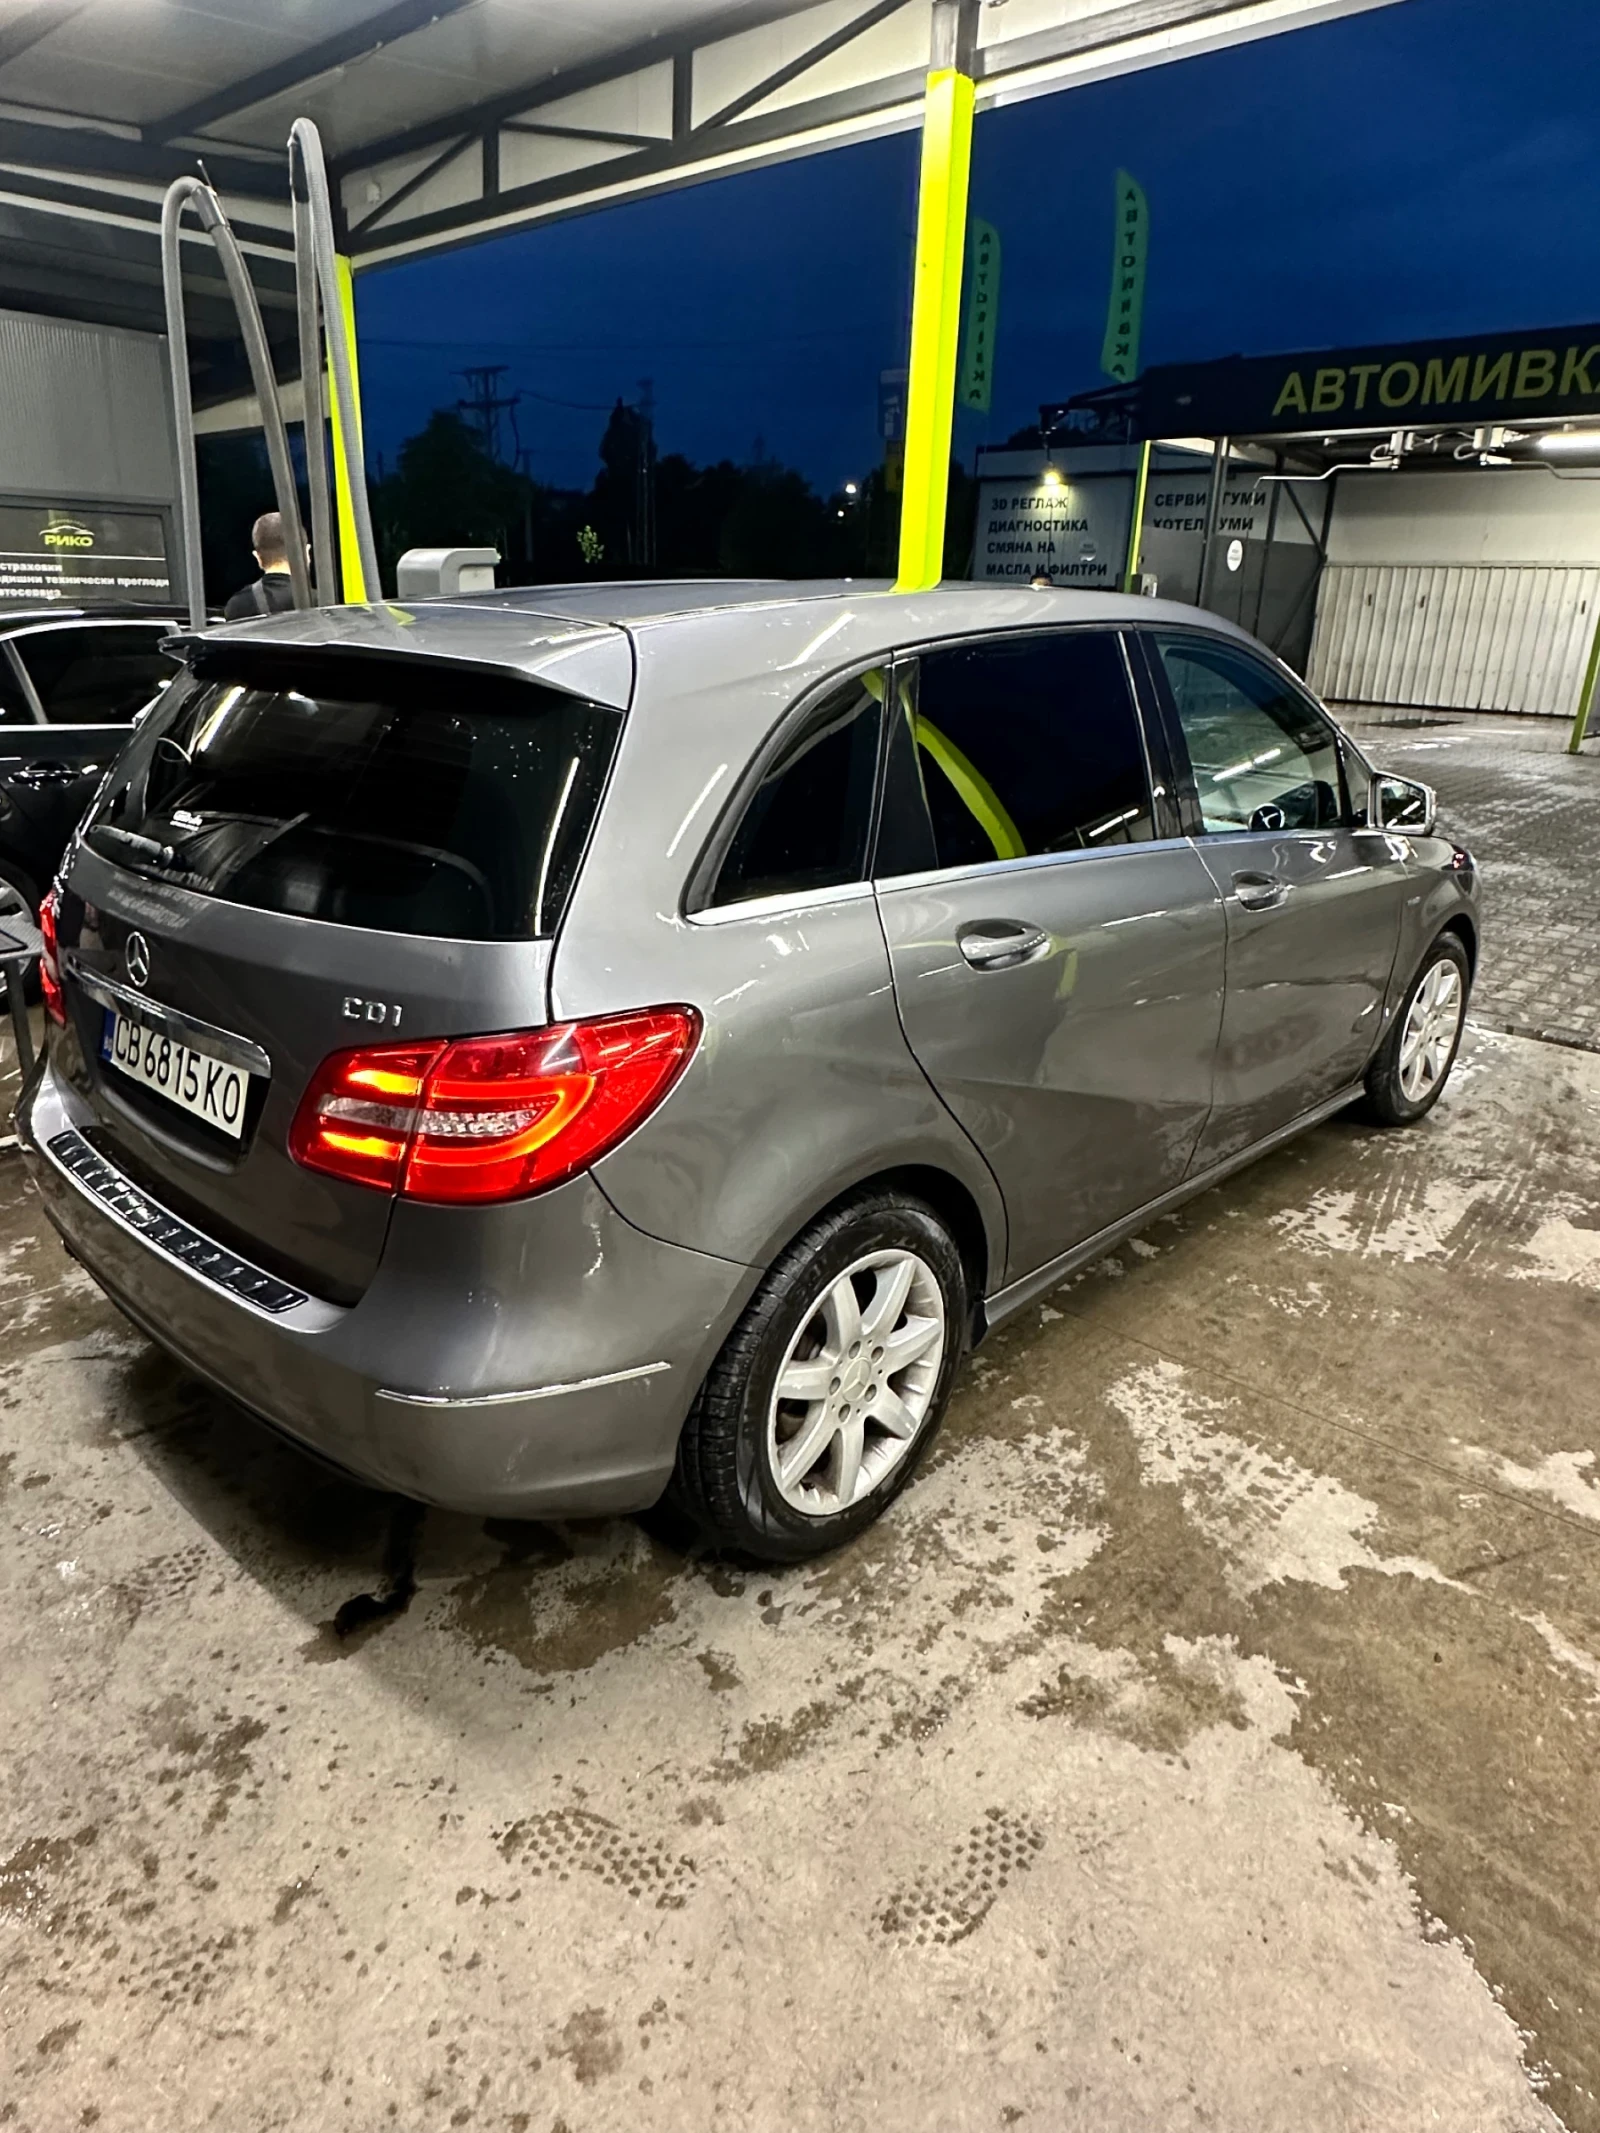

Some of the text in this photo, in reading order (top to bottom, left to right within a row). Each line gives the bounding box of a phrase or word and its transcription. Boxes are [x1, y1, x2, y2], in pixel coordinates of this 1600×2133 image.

[1271, 343, 1600, 417] АВТОМИВК
[1011, 497, 1068, 510] РЕГЛАЖ
[1154, 492, 1207, 507] СЕРВИ
[988, 519, 1089, 534] ДИАГНОСТИКА
[1218, 517, 1254, 531] УМИ
[44, 534, 94, 547] РИКО
[986, 541, 1056, 554] СМЯНА НА
[985, 563, 1032, 576] МАСЛА
[1048, 563, 1108, 576] ФИЛТРИ
[0, 574, 43, 584] дишни
[341, 996, 403, 1027] CDI
